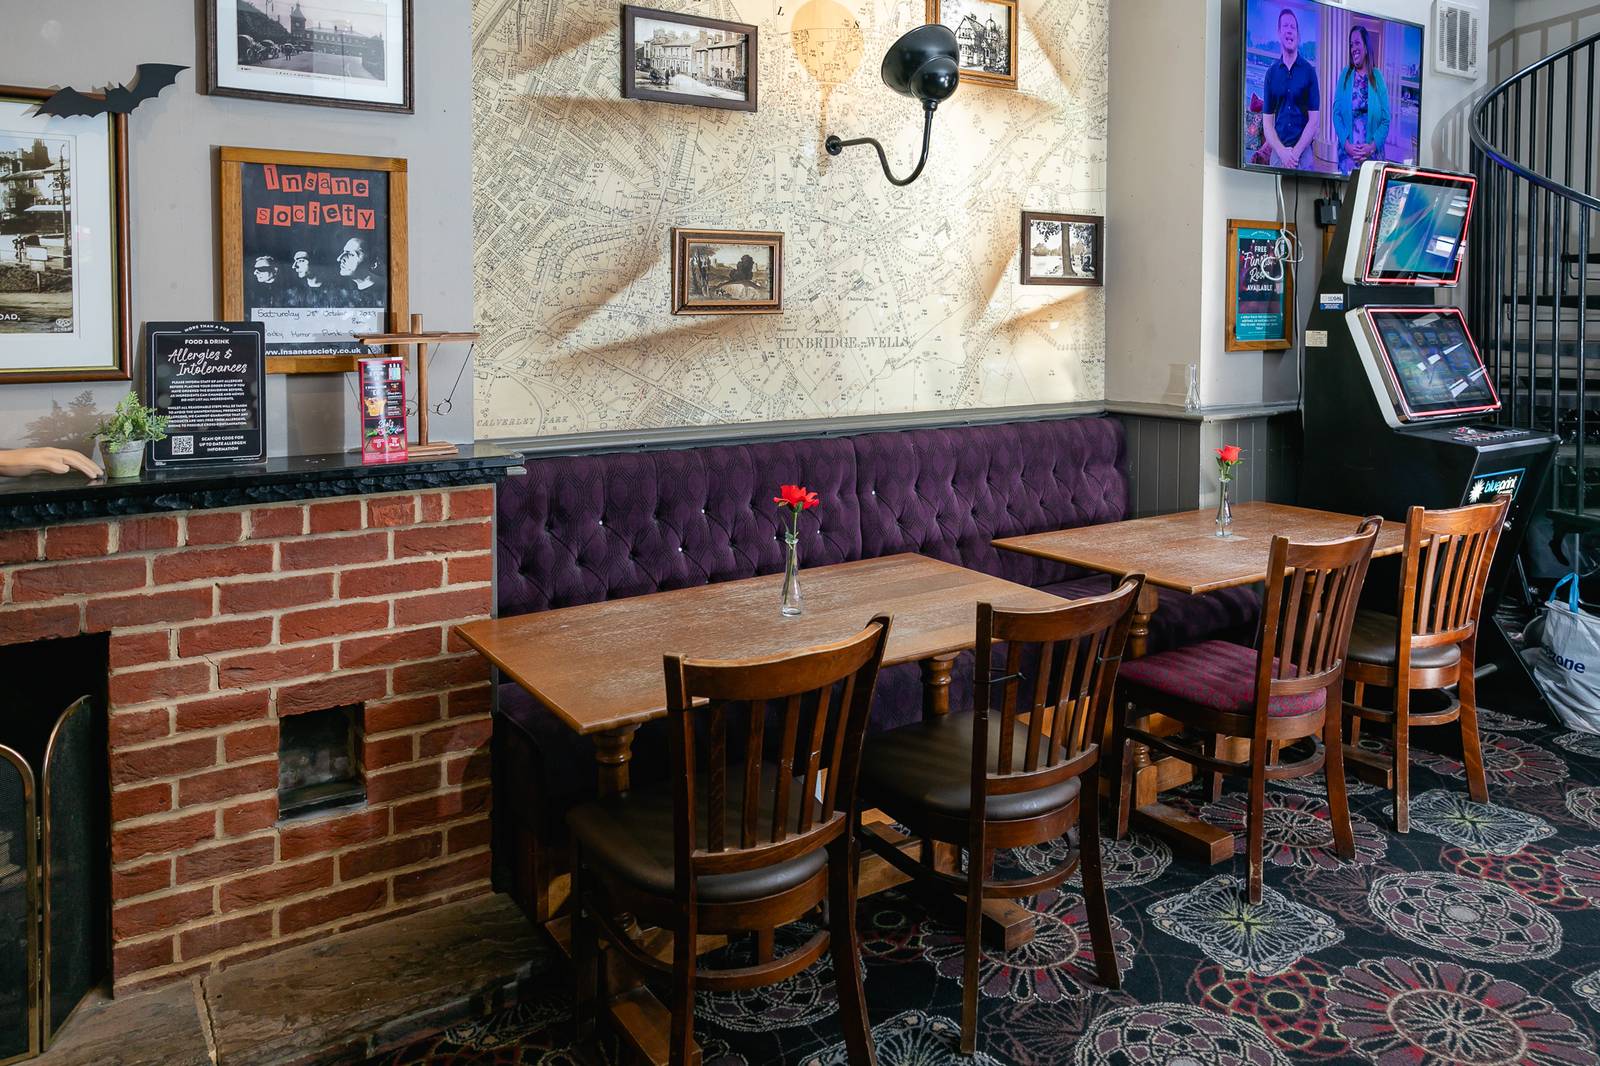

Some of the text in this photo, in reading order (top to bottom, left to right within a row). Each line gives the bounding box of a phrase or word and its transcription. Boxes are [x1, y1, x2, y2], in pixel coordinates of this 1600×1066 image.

[264, 165, 368, 197] Insane
[256, 202, 375, 229] society
[257, 309, 299, 320] Saturday
[168, 348, 220, 365] Allergies
[176, 362, 248, 376] Intolerances
